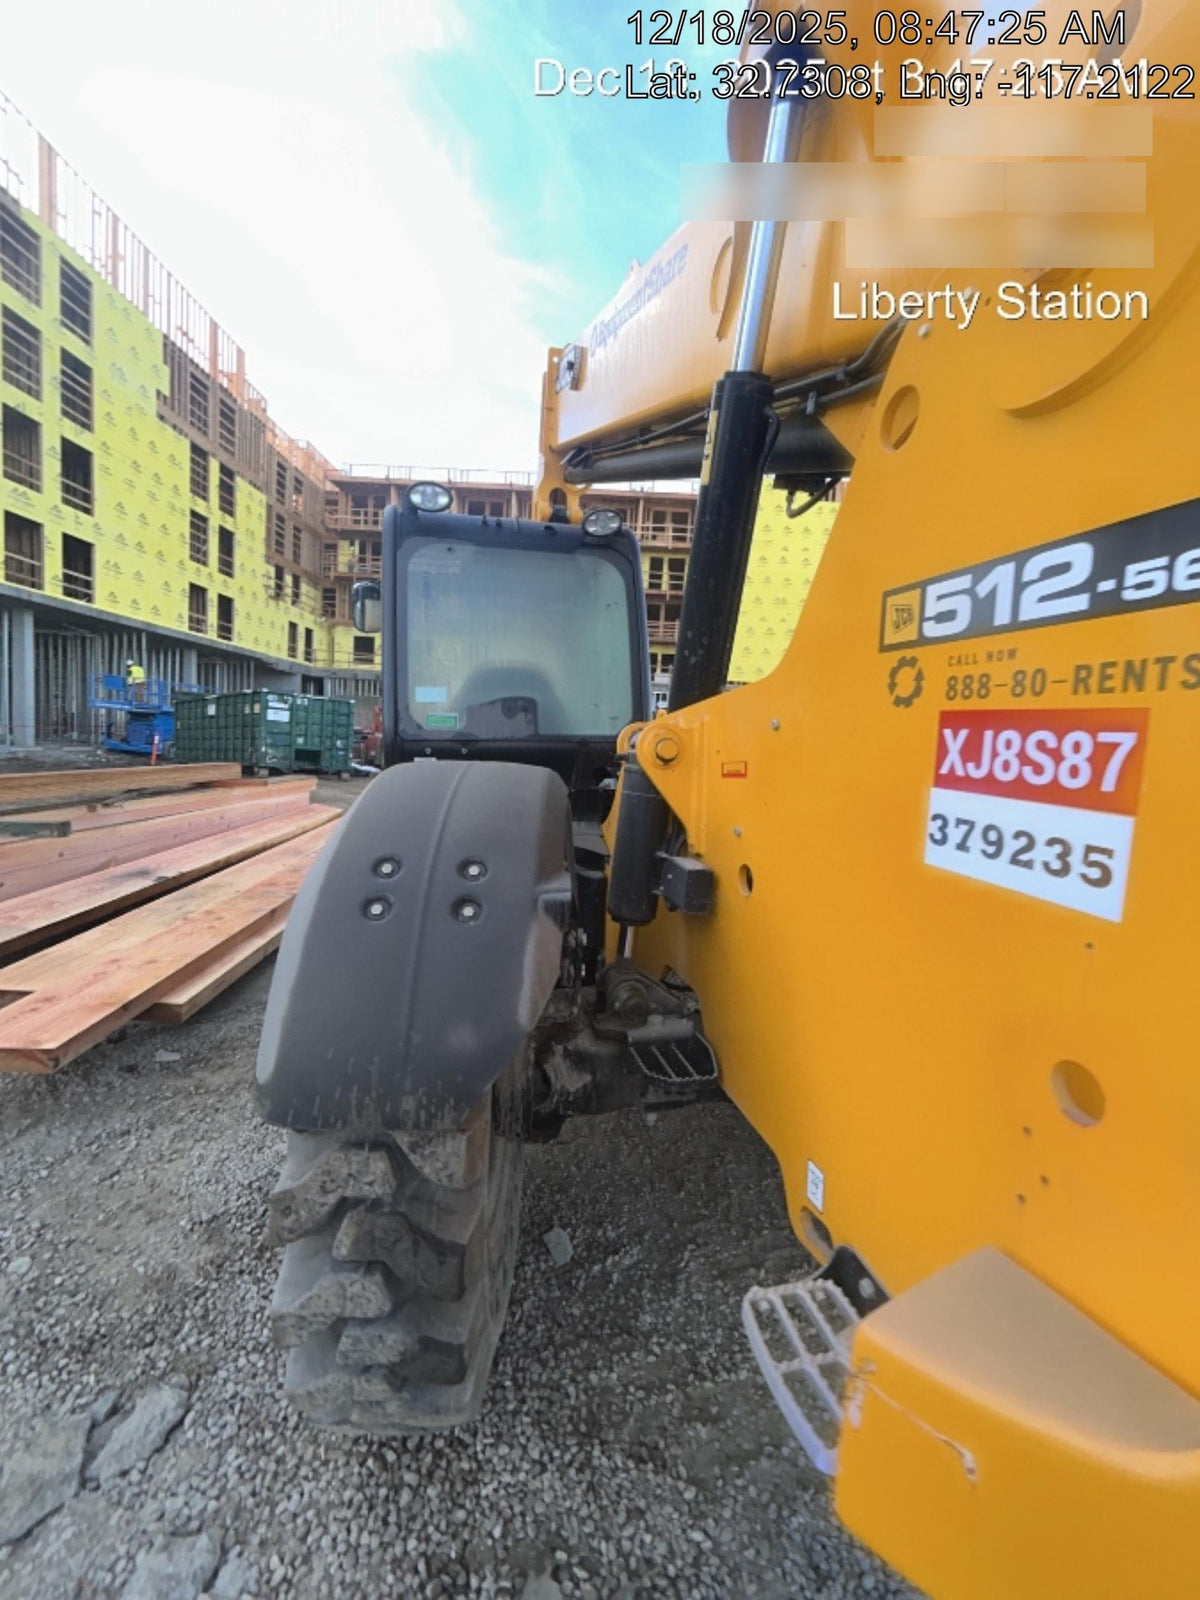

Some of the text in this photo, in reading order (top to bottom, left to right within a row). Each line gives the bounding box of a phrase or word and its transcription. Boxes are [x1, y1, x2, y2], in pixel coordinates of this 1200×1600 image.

[947, 647, 1019, 668] CALL NOW
[938, 728, 1139, 793] XJ8S87
[928, 812, 1116, 890] 379235
